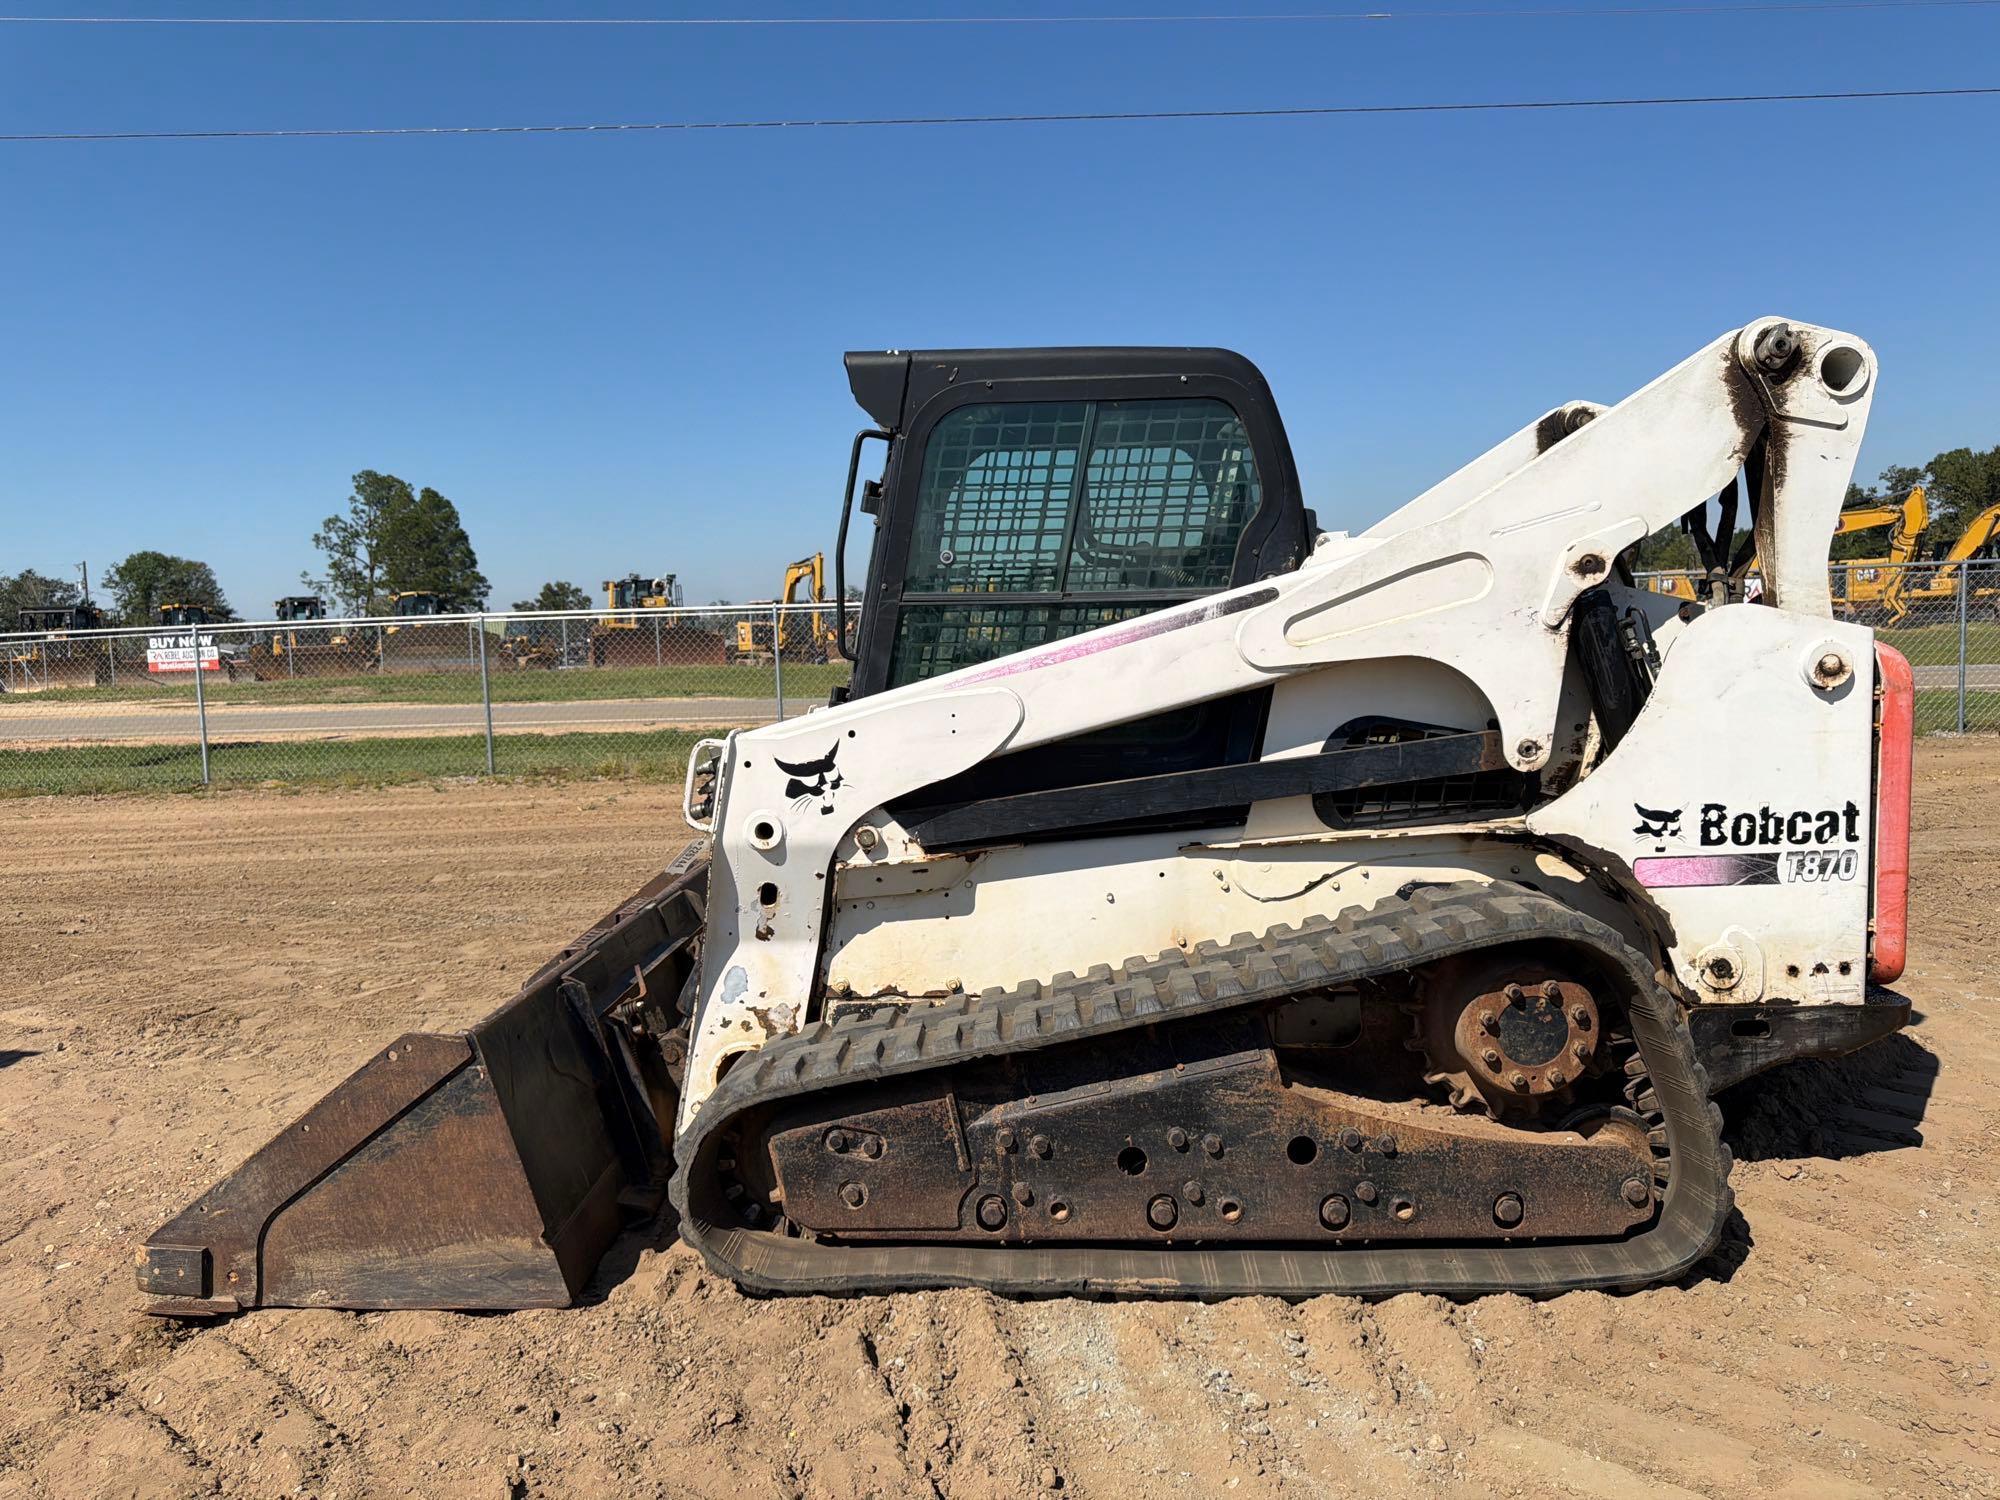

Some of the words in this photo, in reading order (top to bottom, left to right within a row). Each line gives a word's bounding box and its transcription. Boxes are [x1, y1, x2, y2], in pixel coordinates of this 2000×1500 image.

[1857, 569, 1875, 581] CAT
[149, 637, 175, 649] BUY
[1700, 800, 1860, 846] Bobcat
[1786, 849, 1858, 883] T870
